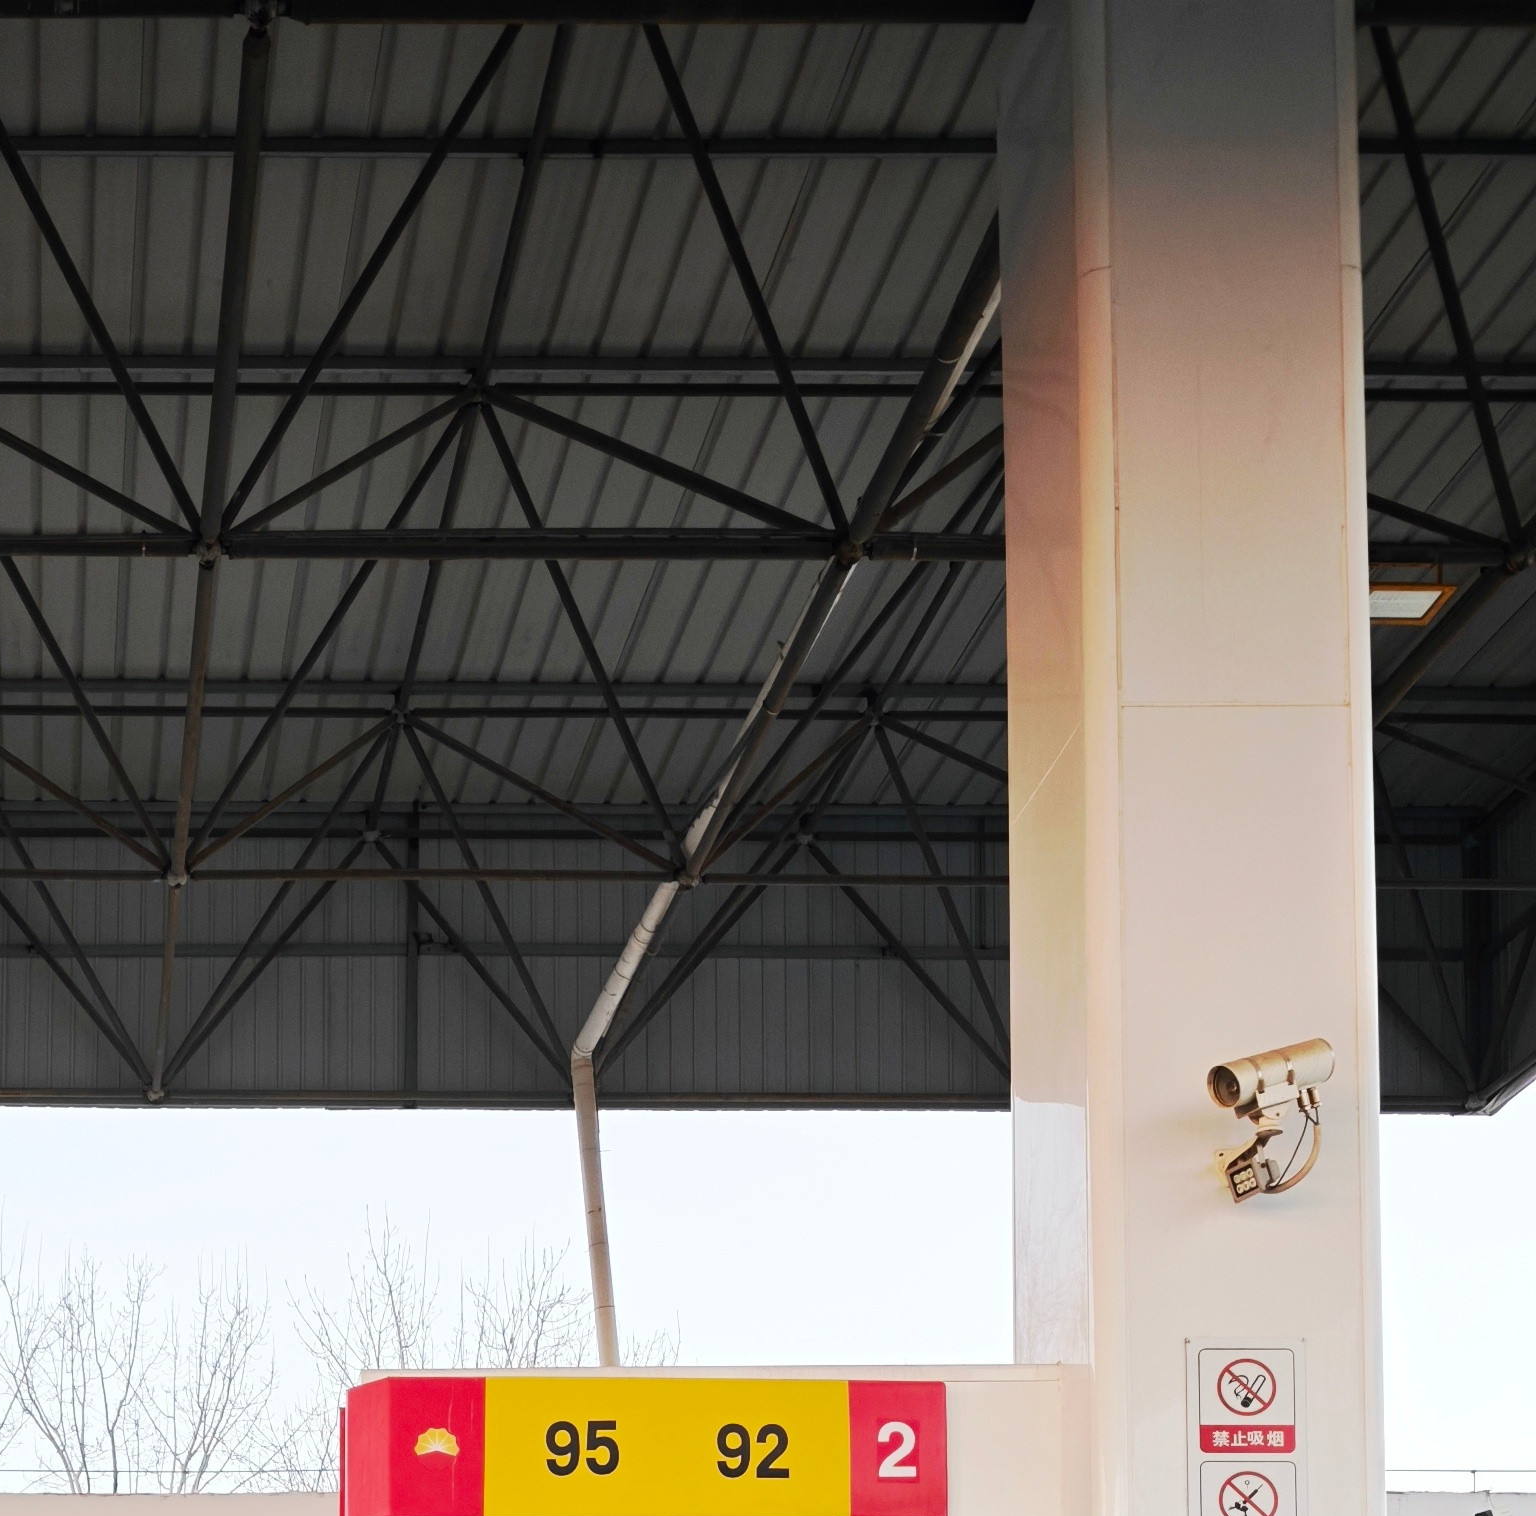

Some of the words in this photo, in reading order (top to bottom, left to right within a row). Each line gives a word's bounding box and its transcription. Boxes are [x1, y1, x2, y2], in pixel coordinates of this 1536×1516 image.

[546, 1420, 620, 1476] 95
[716, 1423, 790, 1479] 92
[877, 1421, 917, 1478] 2
[1212, 1430, 1284, 1448] 禁止吸烟
